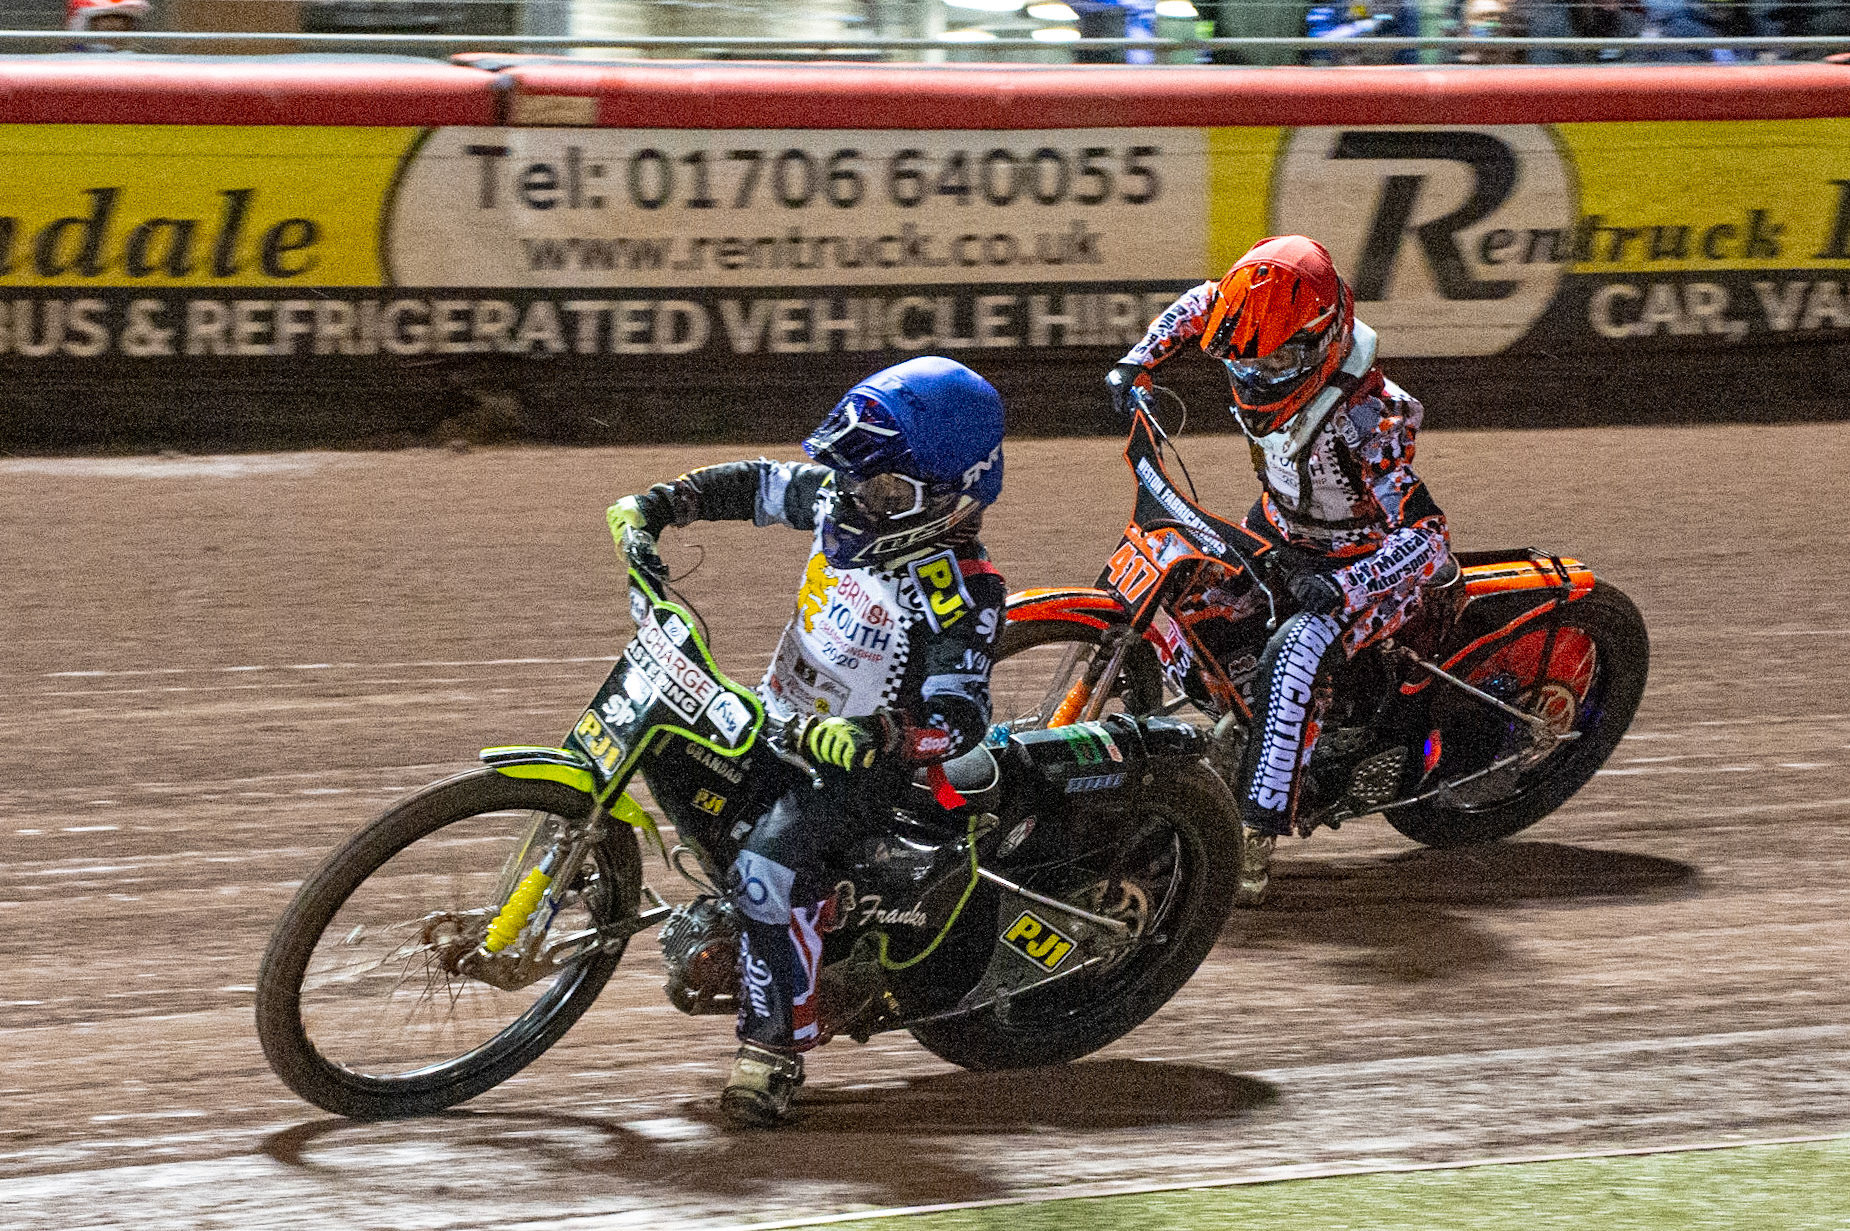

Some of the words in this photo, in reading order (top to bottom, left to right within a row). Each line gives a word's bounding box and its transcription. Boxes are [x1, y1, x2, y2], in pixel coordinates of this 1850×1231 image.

[466, 145, 604, 209] Tel:
[626, 148, 865, 209] 01706
[887, 145, 1163, 205] 640055
[0, 186, 321, 279] dale
[517, 218, 1101, 274] www.rentruck.co.uk
[0, 298, 109, 357] US
[123, 299, 175, 356] &
[184, 297, 709, 356] REFRIGERATED
[719, 293, 1018, 354] VEHICLE
[1589, 281, 1750, 343] CAR,
[1137, 456, 1165, 496] WESTON
[1161, 486, 1227, 555] FABRICATIONS
[837, 573, 895, 631] BRITISH
[917, 558, 969, 630] PJ1
[1107, 541, 1160, 604] 417
[822, 641, 860, 670] 2020
[827, 596, 892, 652] YOUTH
[645, 627, 714, 701] CHARGE
[578, 712, 621, 770] PJ1
[1257, 613, 1342, 812] FABRICATIONS
[1005, 915, 1072, 967] PJ1
